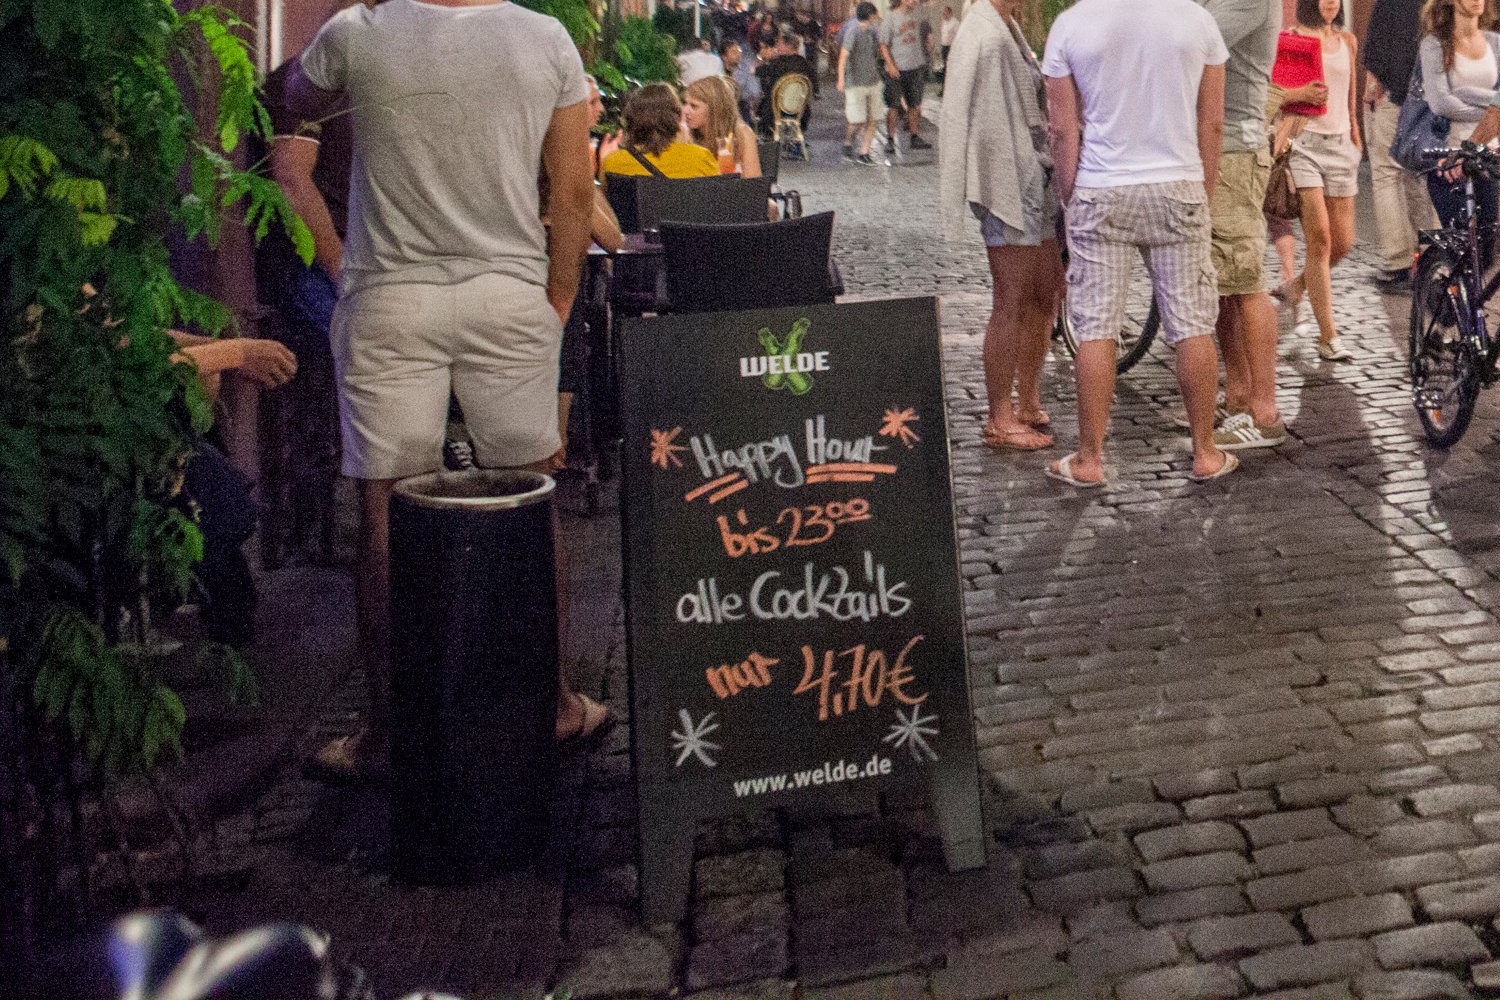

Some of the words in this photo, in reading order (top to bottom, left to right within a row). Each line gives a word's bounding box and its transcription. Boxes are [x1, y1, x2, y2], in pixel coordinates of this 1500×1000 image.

[740, 351, 830, 377] WELDE
[690, 433, 804, 488] Happy
[806, 414, 888, 463] Hour
[717, 508, 779, 557] bis
[676, 577, 746, 624] alle
[750, 550, 911, 622] Cocktails
[705, 653, 780, 699] nur
[733, 754, 892, 797] www.welde.de
